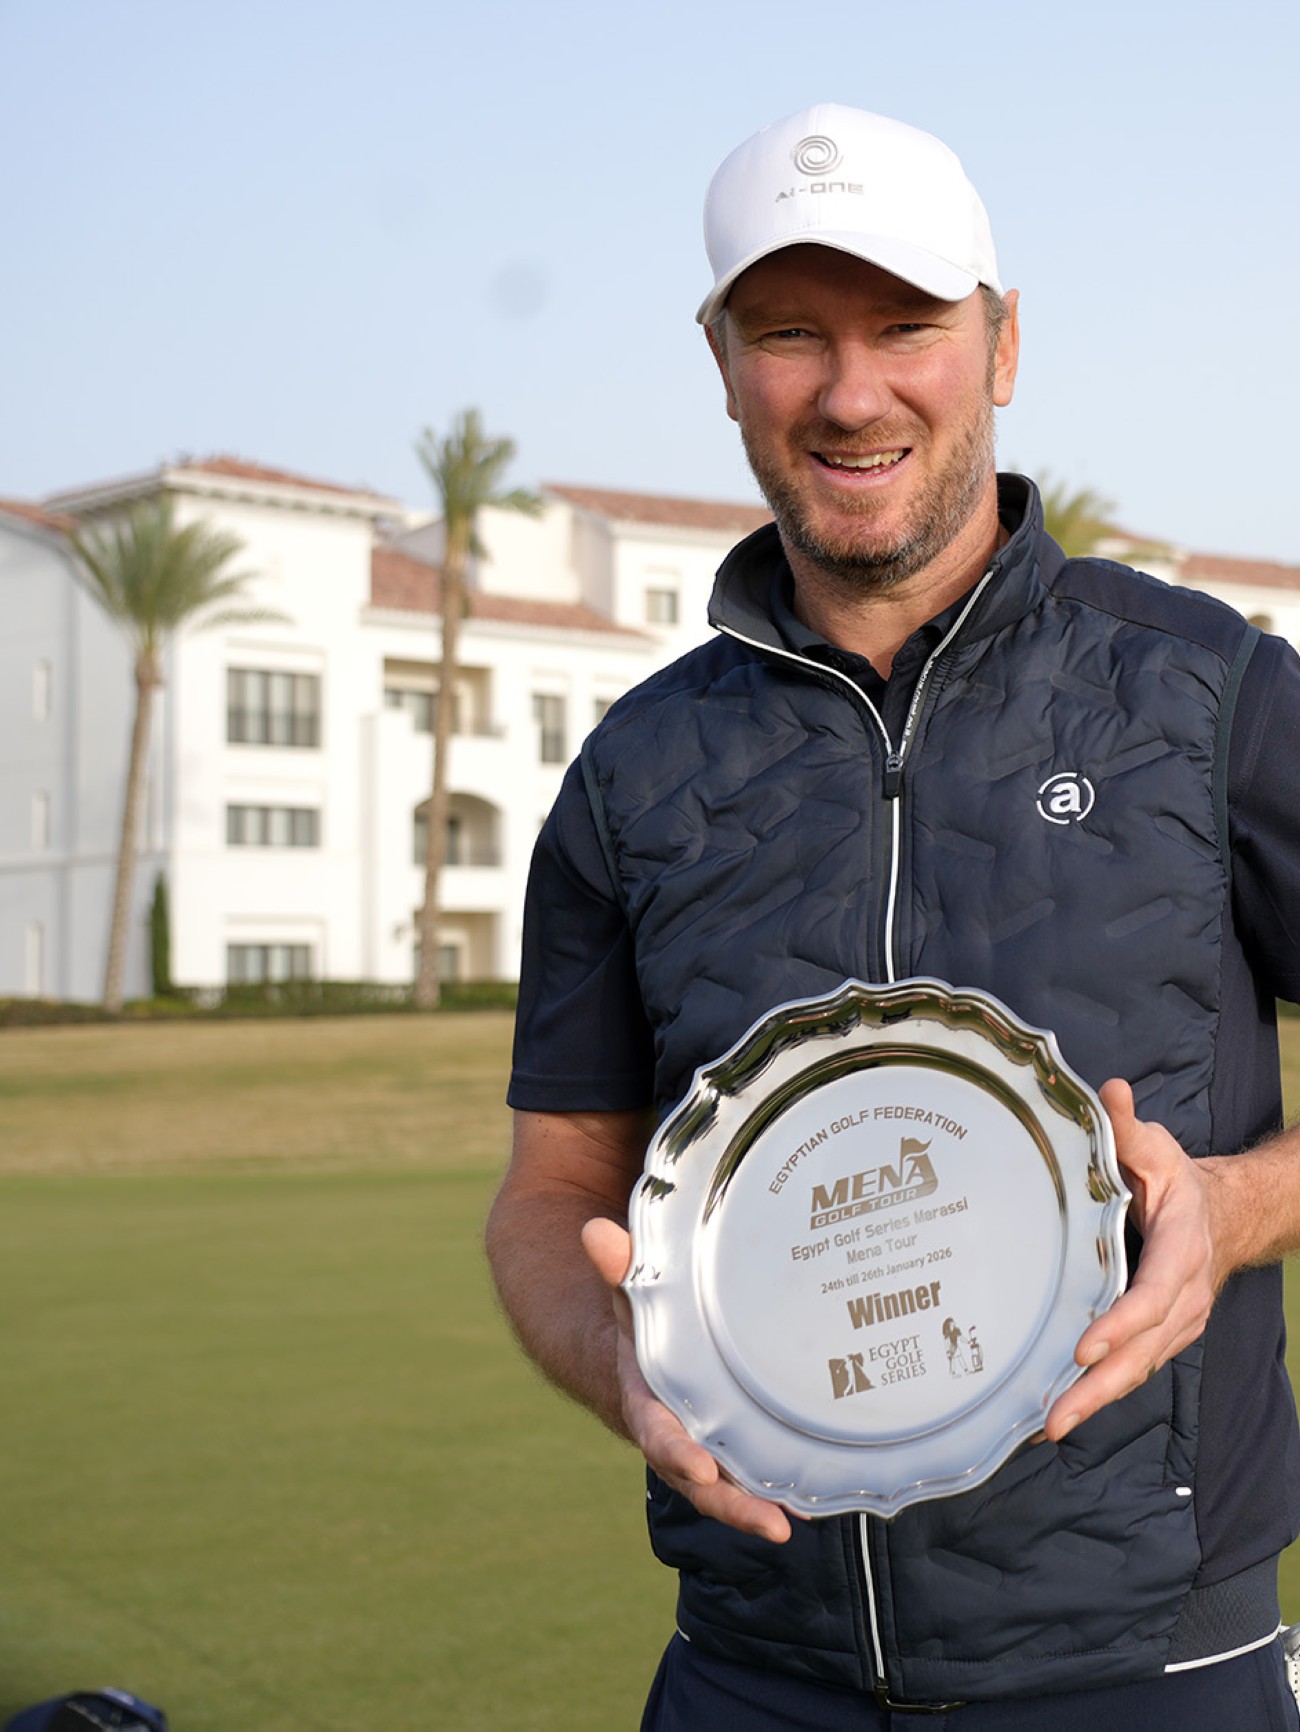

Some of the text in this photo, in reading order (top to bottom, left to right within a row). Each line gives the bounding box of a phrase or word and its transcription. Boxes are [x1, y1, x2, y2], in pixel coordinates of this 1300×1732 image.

[769, 1106, 969, 1195] EGYPTIAN GOLF FEDERATION
[811, 1137, 938, 1213] MENA
[791, 1197, 969, 1261] Egypt Golf Series Marassi
[814, 1188, 918, 1228] GOLF TOUR
[821, 1247, 953, 1294] 24th till 26th January 2026
[847, 1234, 918, 1264] Mena Tour
[847, 1280, 942, 1330] Winner
[869, 1334, 921, 1362] EGYPT
[885, 1350, 924, 1370] GOLF
[880, 1362, 927, 1386] SERIES
